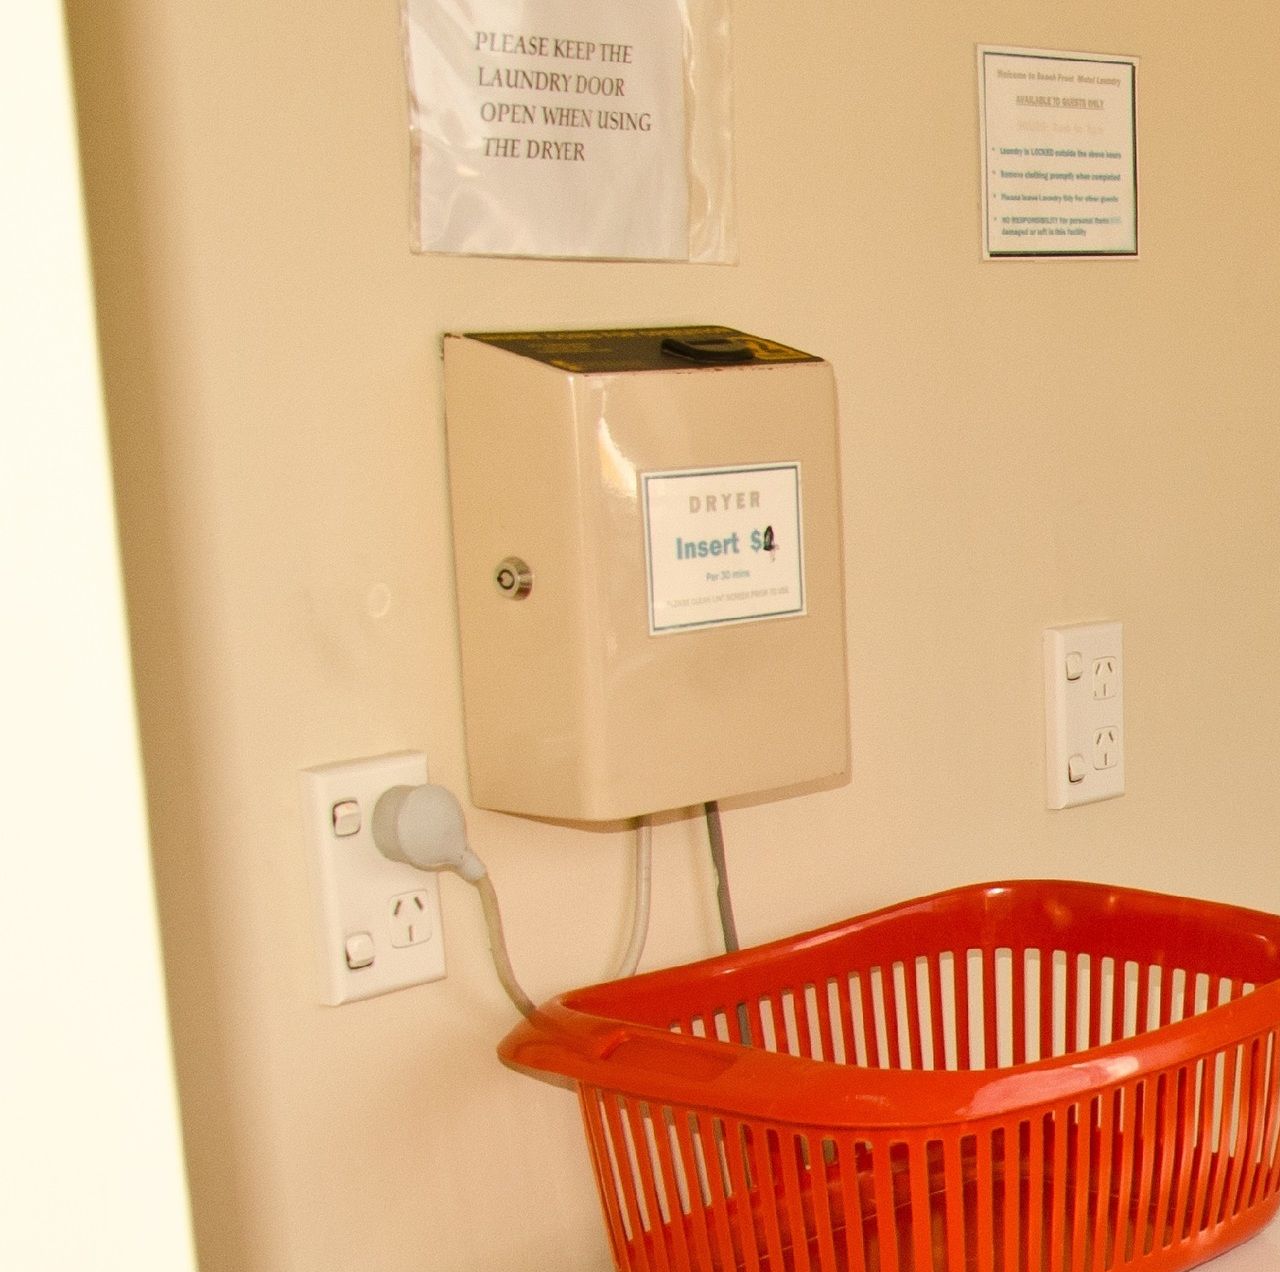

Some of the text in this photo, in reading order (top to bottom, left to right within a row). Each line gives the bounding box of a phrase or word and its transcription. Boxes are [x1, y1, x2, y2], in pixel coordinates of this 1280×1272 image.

[475, 31, 633, 64] PLEASE KEEP THE
[478, 66, 625, 97] LAUNDRY DOOR
[480, 102, 652, 132] OPEN WHEN USING
[483, 137, 586, 162] THE DRYER
[689, 490, 760, 514] DRYER
[676, 532, 740, 560] Insert
[706, 572, 719, 582] Per
